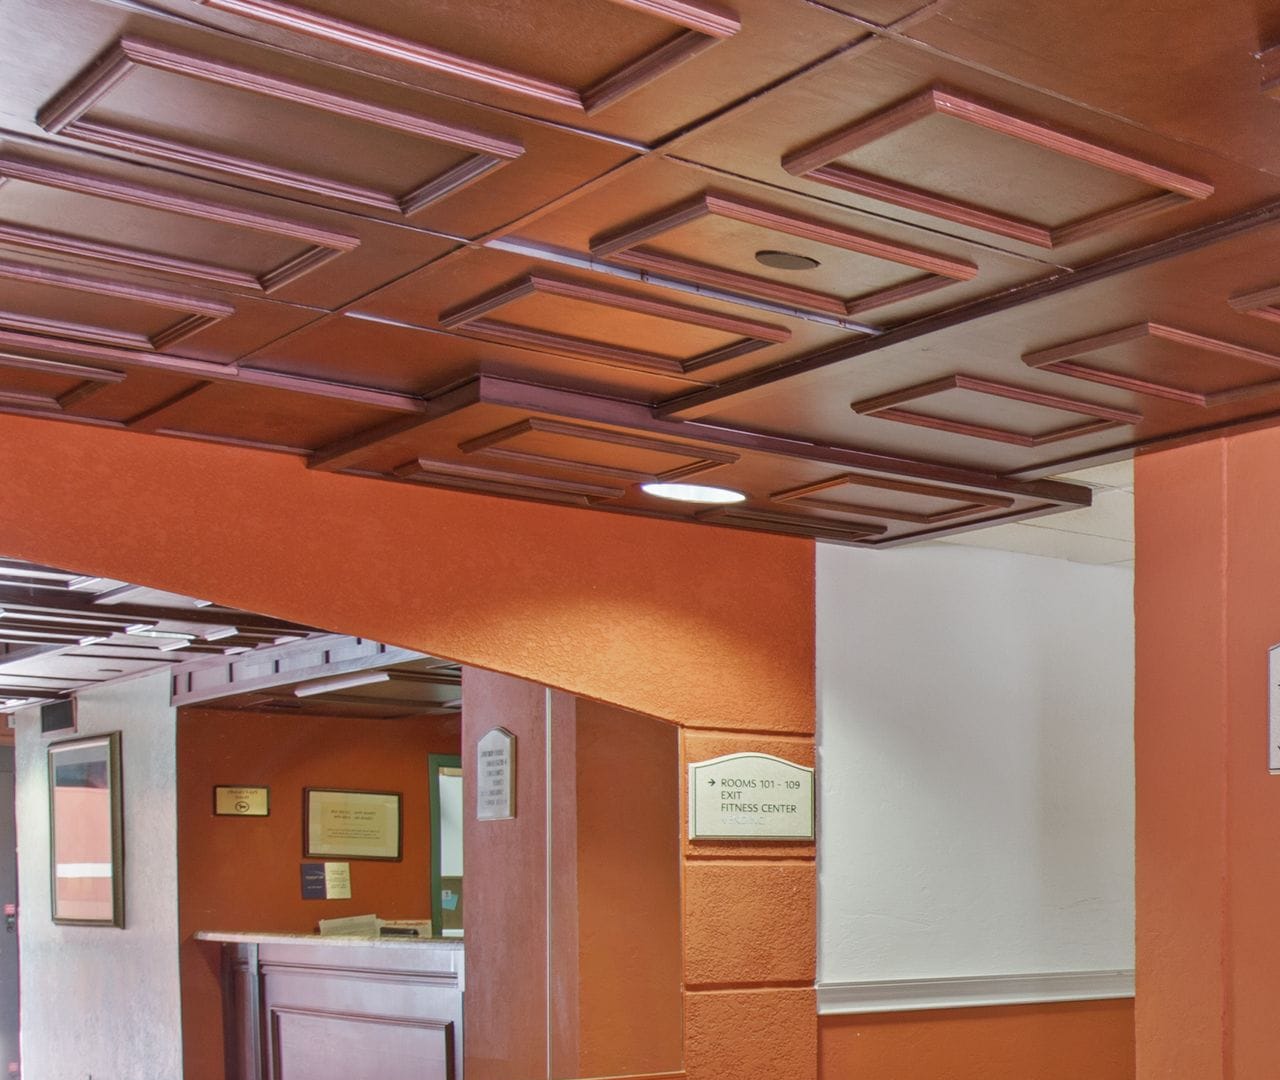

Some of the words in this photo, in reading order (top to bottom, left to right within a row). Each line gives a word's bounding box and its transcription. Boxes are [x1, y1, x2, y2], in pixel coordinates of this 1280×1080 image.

[721, 778, 757, 788] ROOMS
[721, 791, 742, 800] EXIT
[721, 803, 758, 813] FITNESS
[761, 804, 797, 814] CENTER
